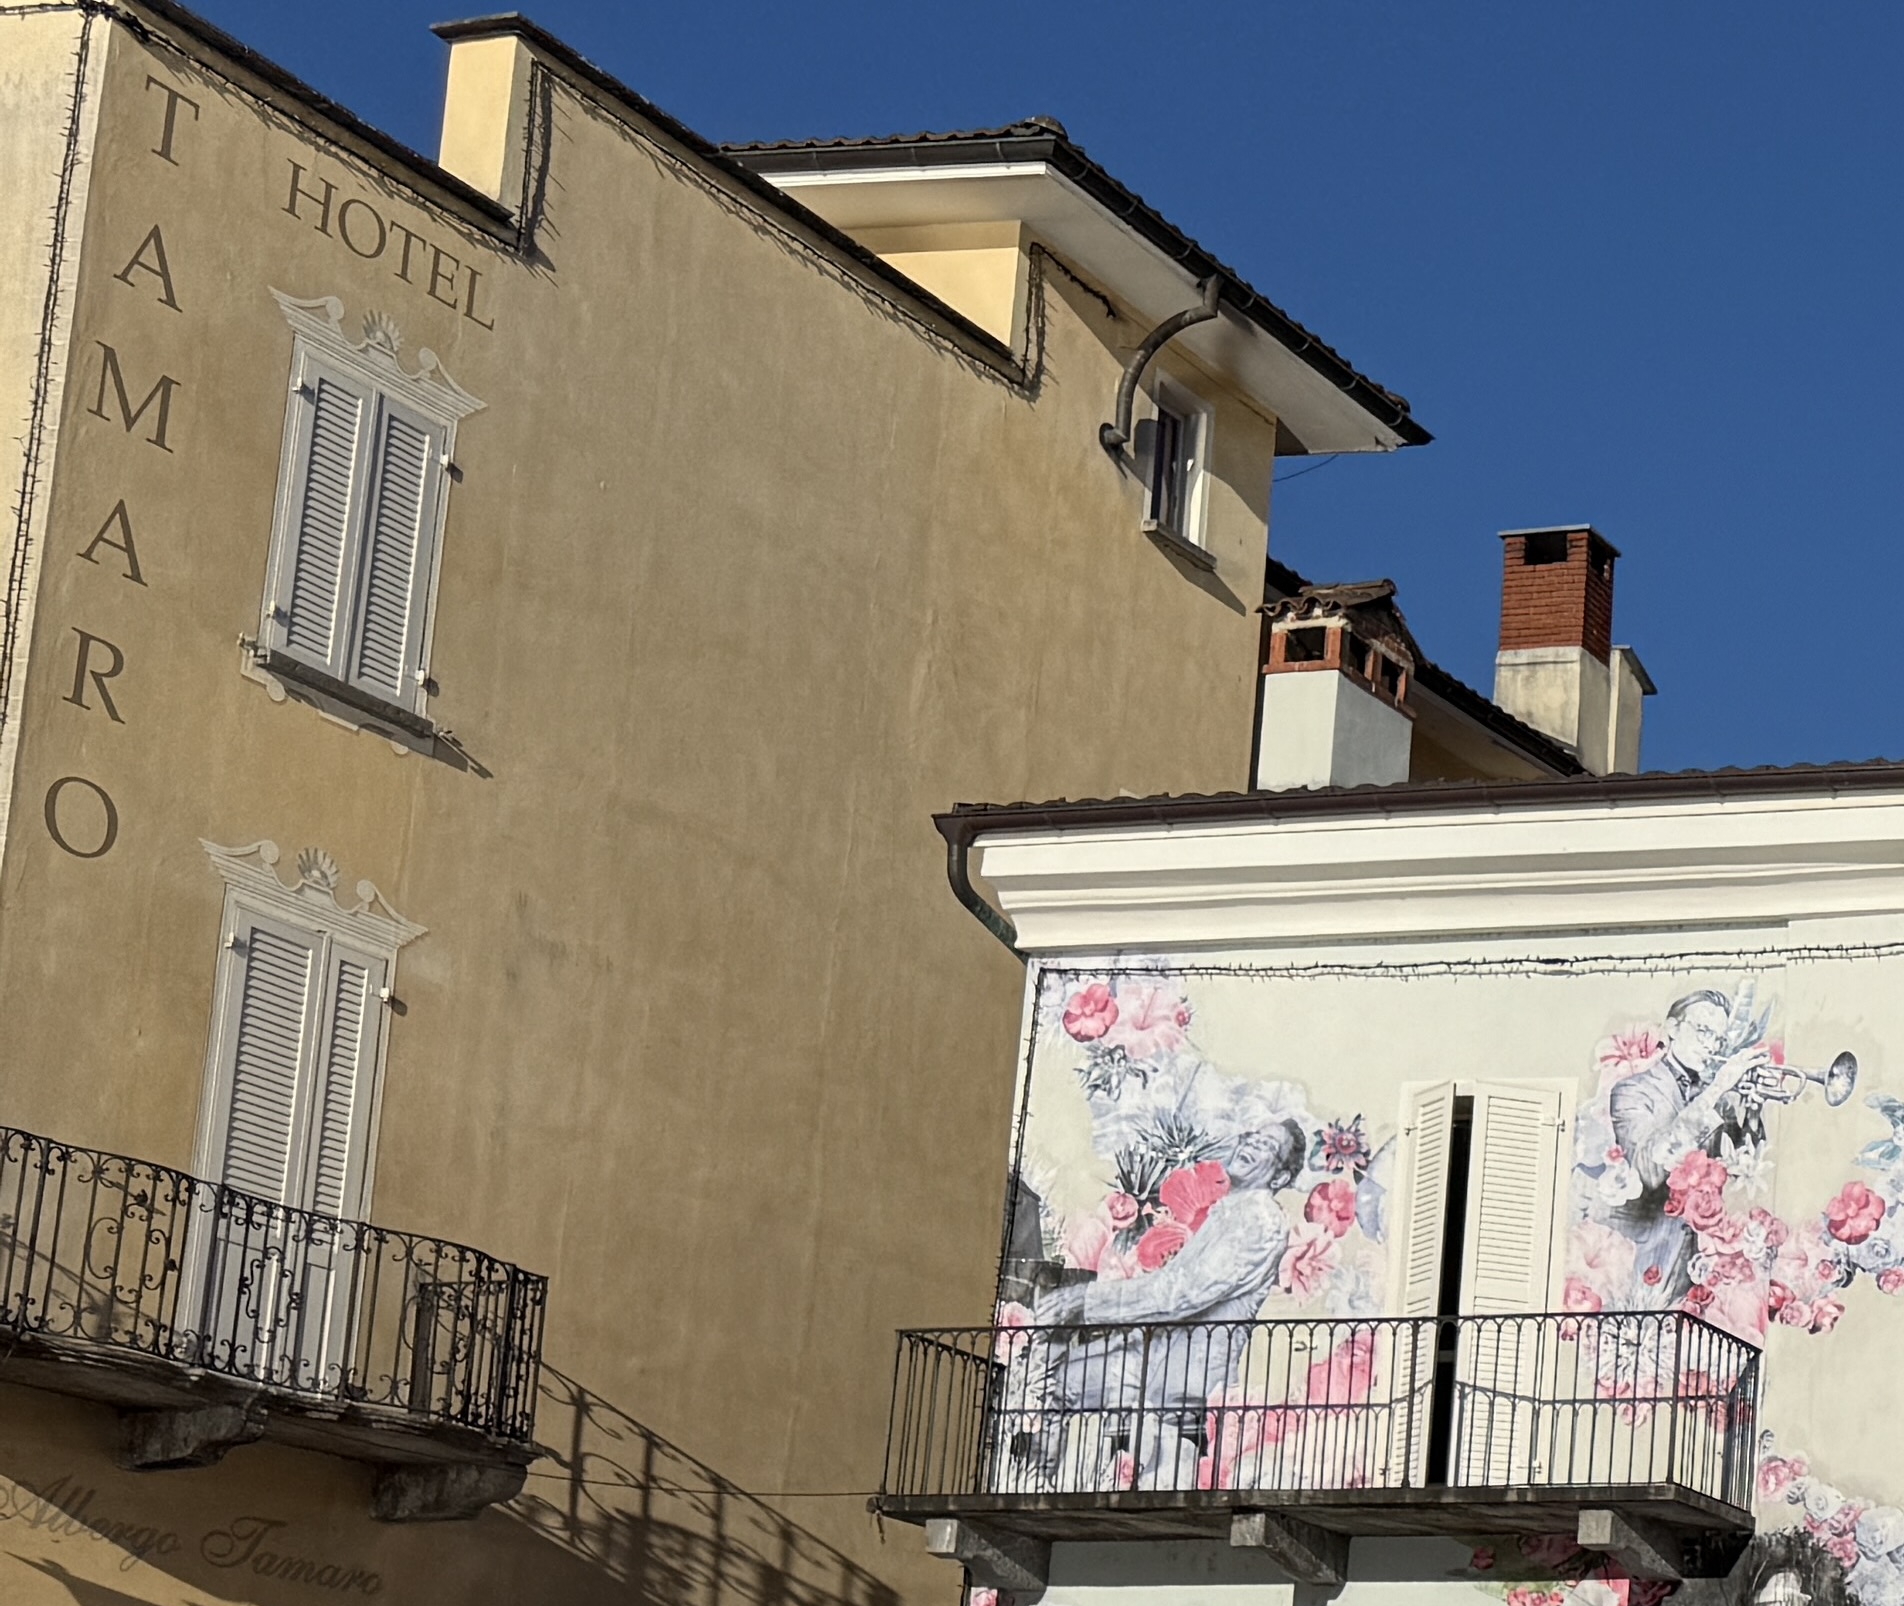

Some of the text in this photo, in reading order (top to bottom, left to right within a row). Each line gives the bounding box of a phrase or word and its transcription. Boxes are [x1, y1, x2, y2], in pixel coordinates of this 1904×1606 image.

[281, 158, 496, 332] HOTEL
[44, 75, 200, 859] TAMARO
[0, 1472, 384, 1596] Albergo Tamaro
